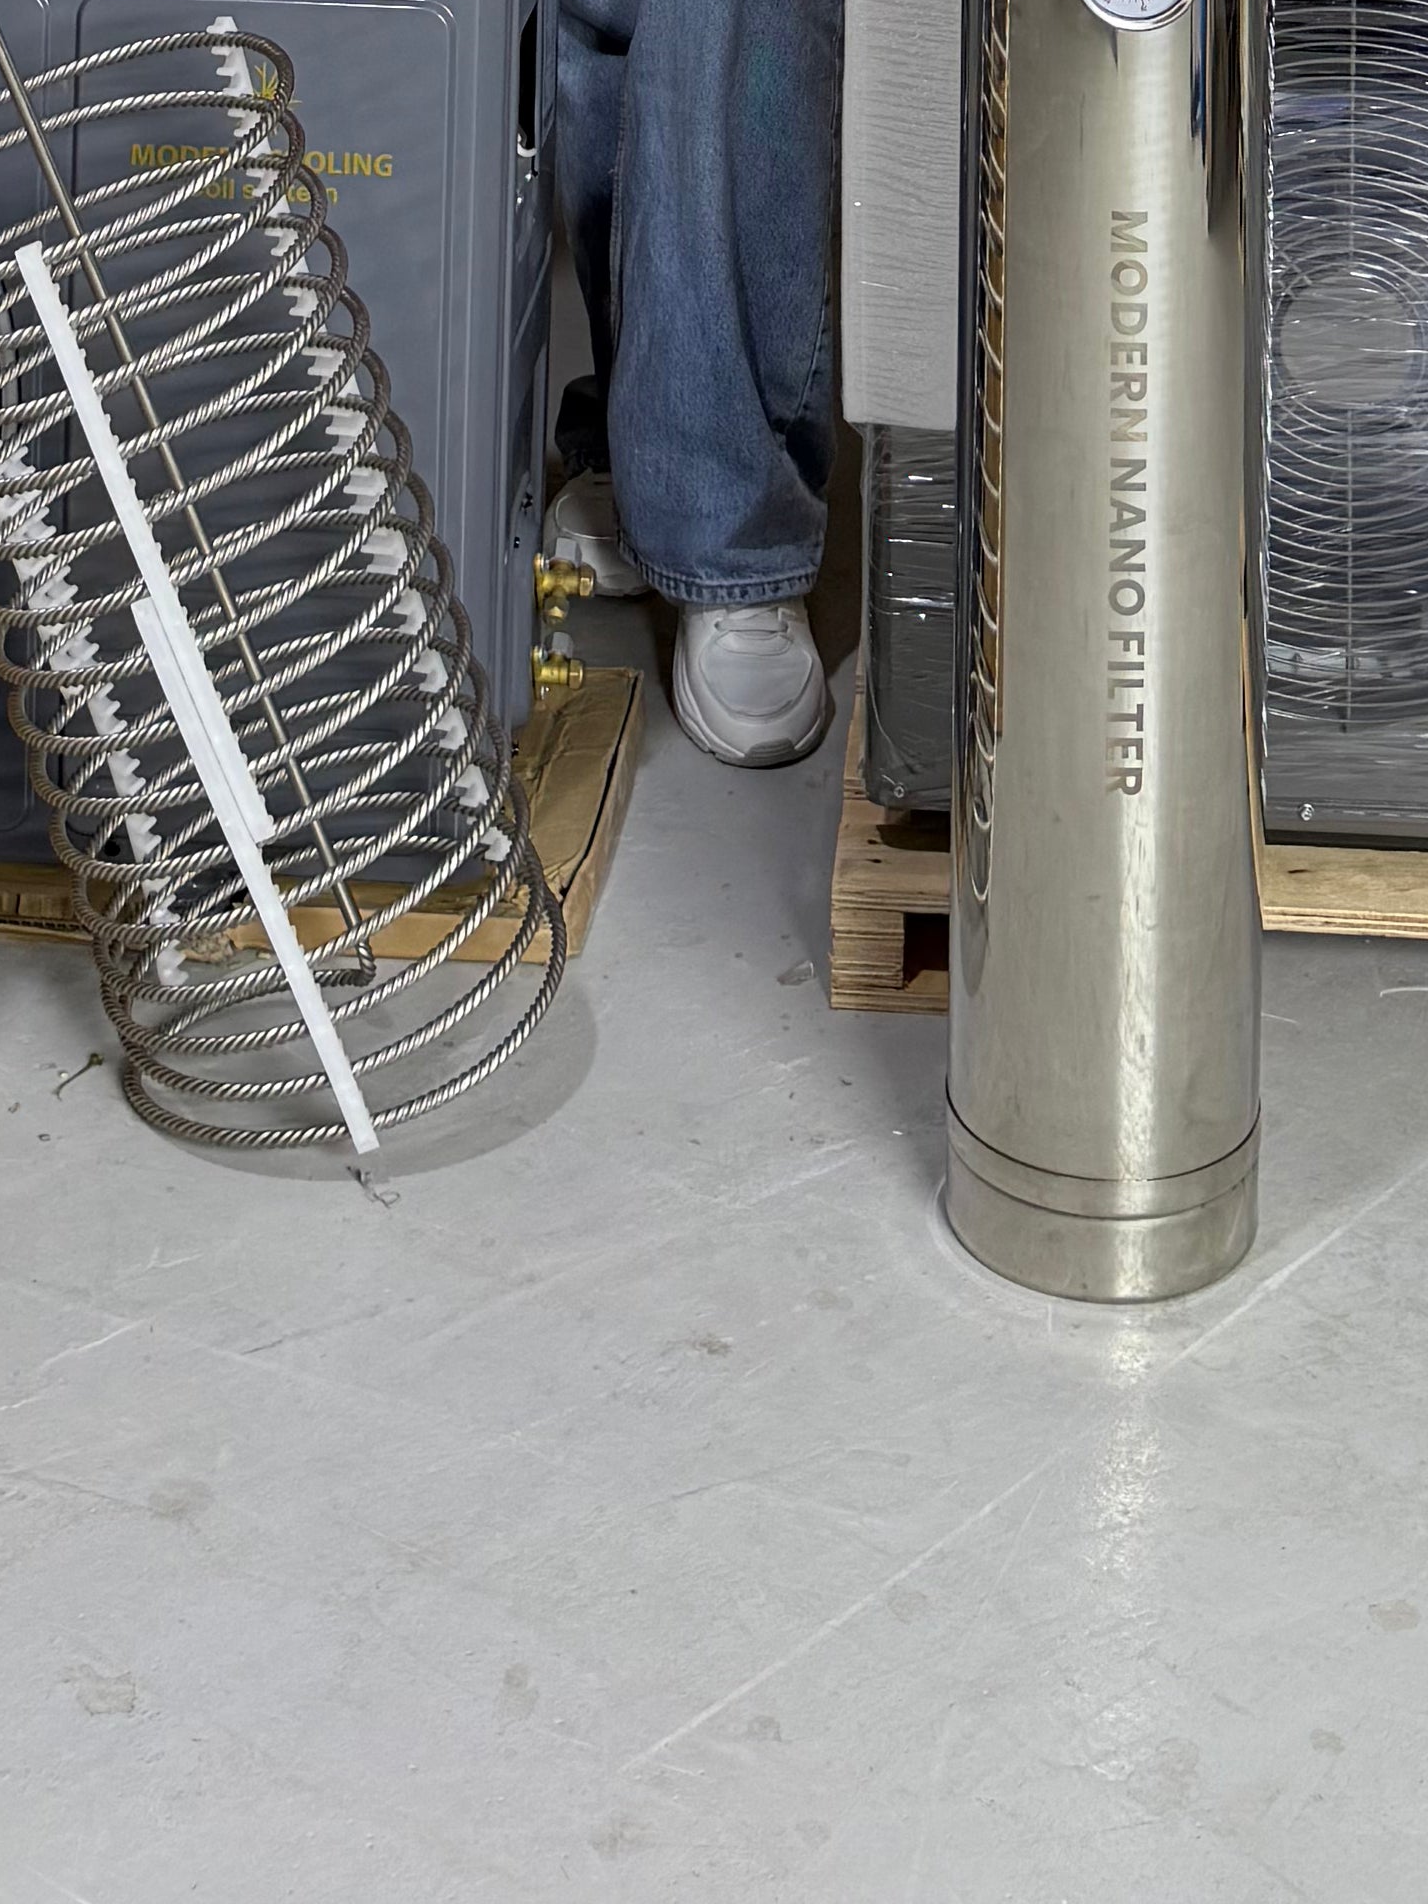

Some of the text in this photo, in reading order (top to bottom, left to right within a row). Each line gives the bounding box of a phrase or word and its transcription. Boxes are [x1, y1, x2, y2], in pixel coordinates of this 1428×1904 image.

[1105, 210, 1148, 797] MODERN NANO FILTER
